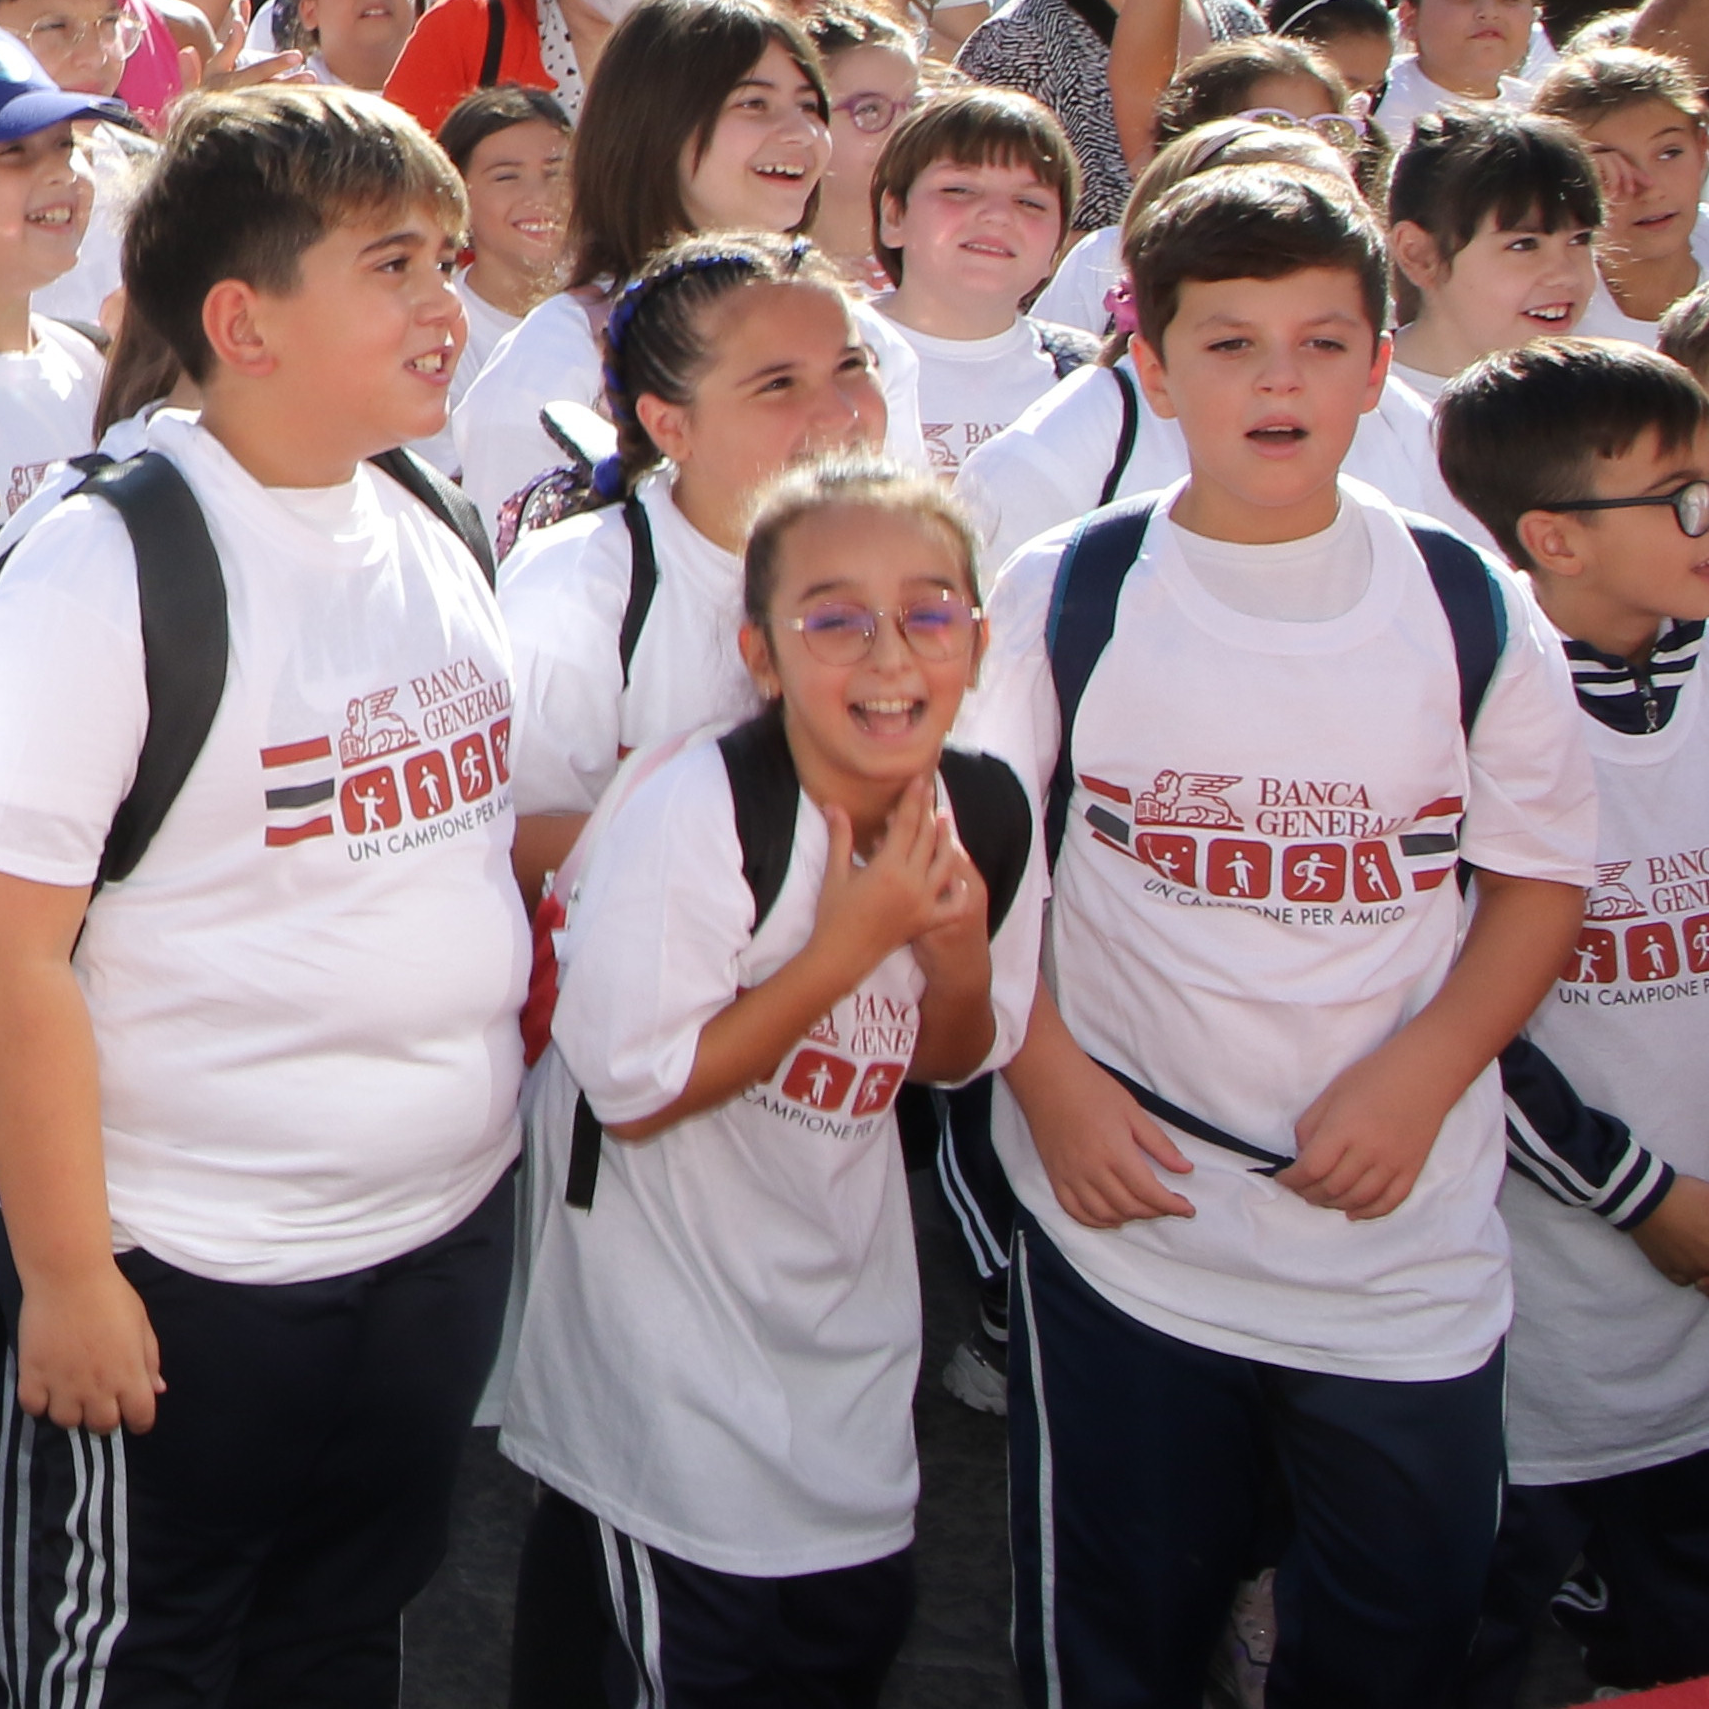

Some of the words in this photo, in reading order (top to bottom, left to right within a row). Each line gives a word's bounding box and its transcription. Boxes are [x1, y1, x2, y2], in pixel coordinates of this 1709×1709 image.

[409, 656, 485, 708] BANCA
[424, 678, 511, 741] GENERALI
[1258, 777, 1372, 810] BANCA
[347, 839, 382, 862] UN
[387, 813, 475, 855] CAMPIONE
[475, 801, 493, 825] PER
[1646, 847, 1709, 885] BANC
[1143, 878, 1173, 899] UN
[1301, 908, 1334, 926] PER
[1340, 905, 1406, 926] AMICO
[1559, 987, 1590, 1005] UN
[1597, 979, 1699, 1006] CAMPIONE
